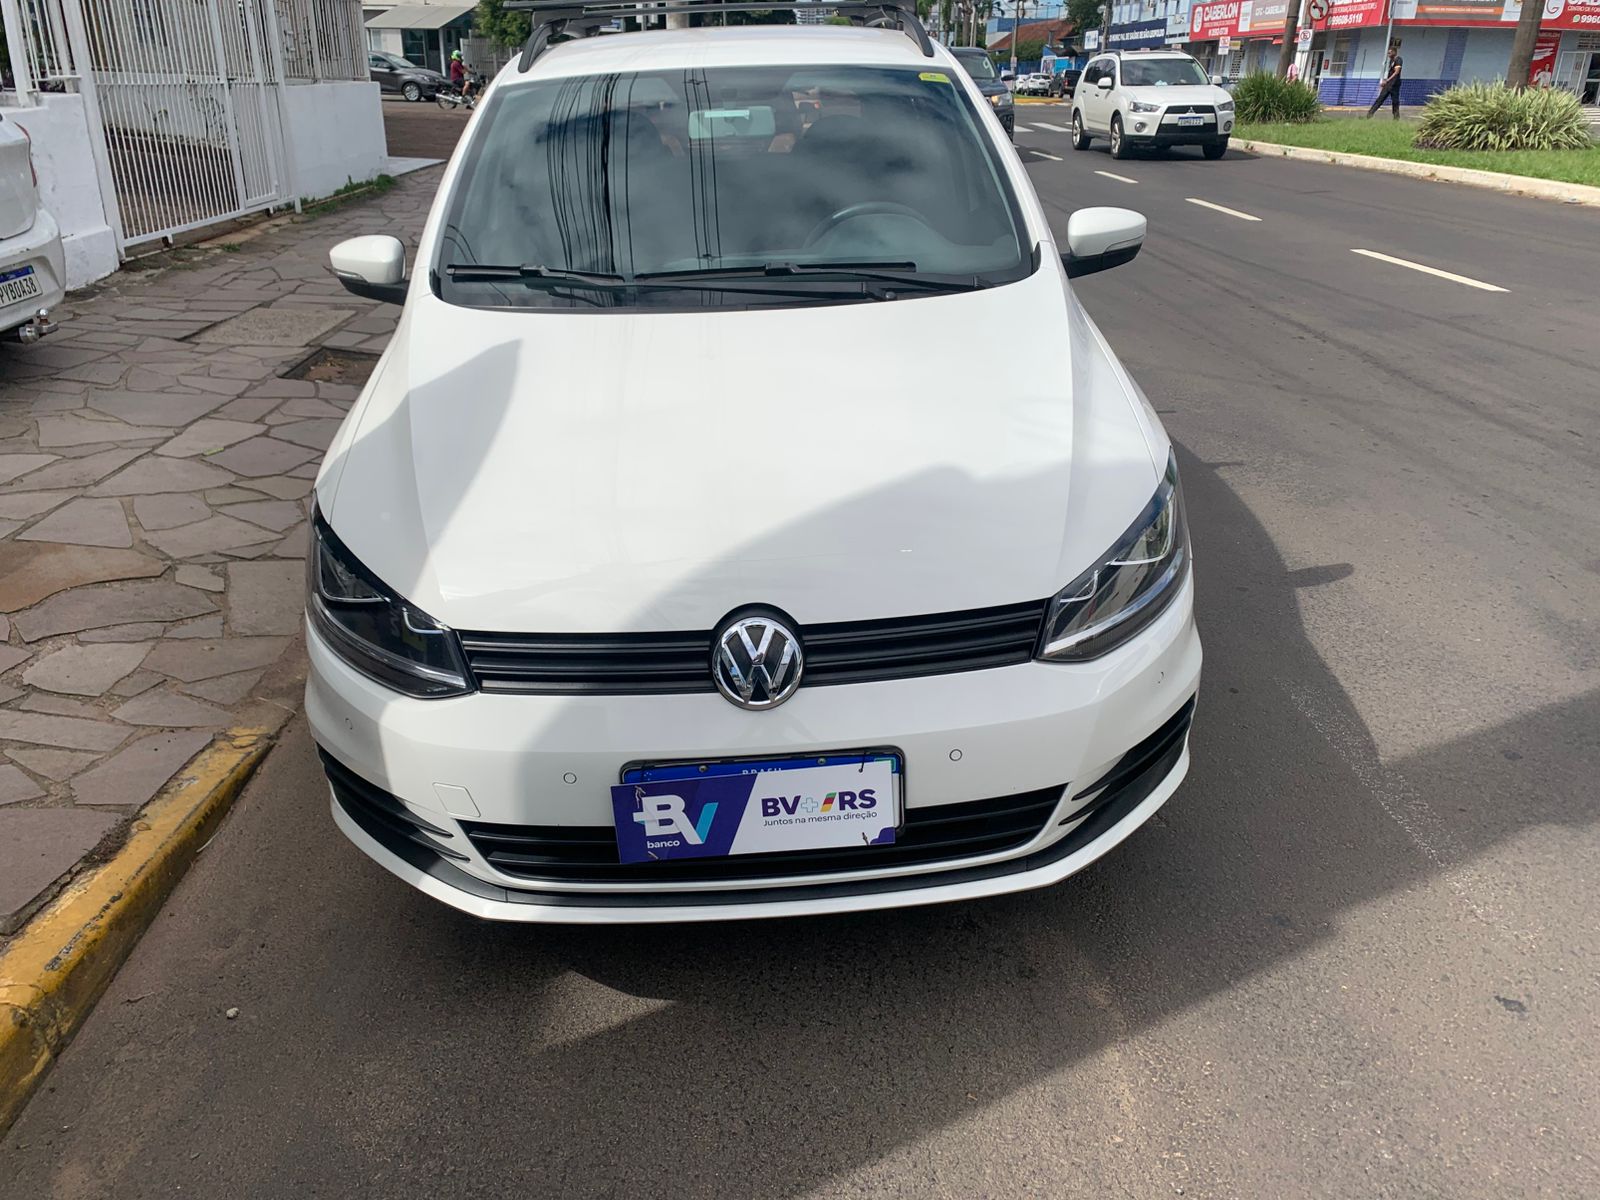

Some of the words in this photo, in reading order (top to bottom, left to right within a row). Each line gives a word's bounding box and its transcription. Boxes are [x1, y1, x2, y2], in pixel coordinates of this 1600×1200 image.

[1203, 2, 1239, 21] CABERLON
[763, 817, 793, 827] Juntos
[807, 814, 842, 824] mesma
[843, 810, 878, 822] direção
[646, 839, 681, 849] banco
